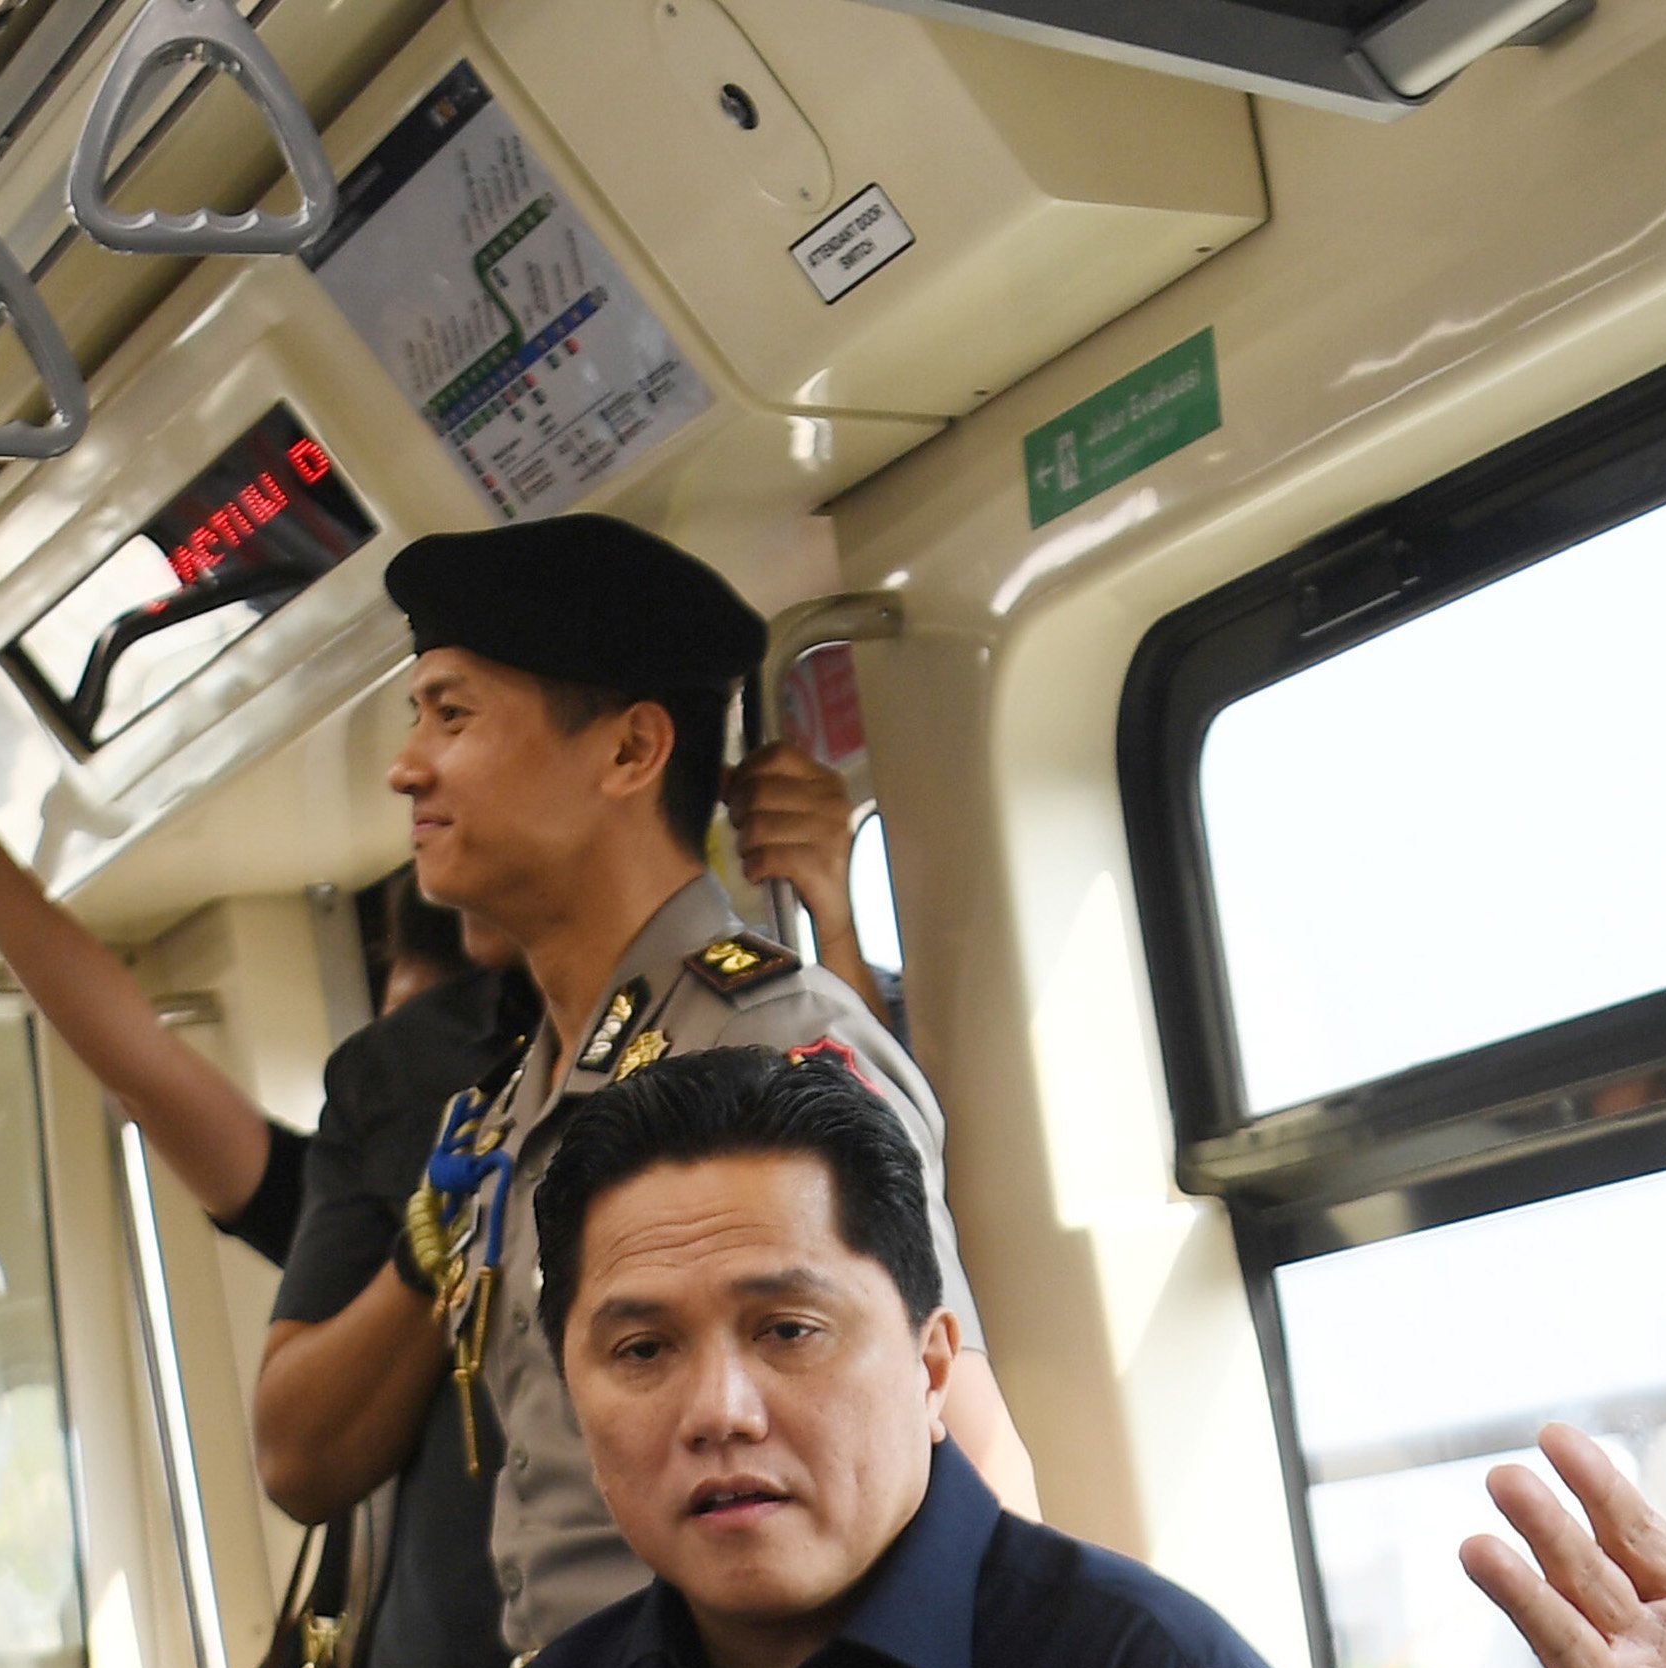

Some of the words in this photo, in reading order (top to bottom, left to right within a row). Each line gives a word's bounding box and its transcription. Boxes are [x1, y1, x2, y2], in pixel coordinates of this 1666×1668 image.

[807, 221, 859, 268] ATTENDANT
[854, 203, 886, 232] DOOR
[839, 238, 878, 271] SWITCH
